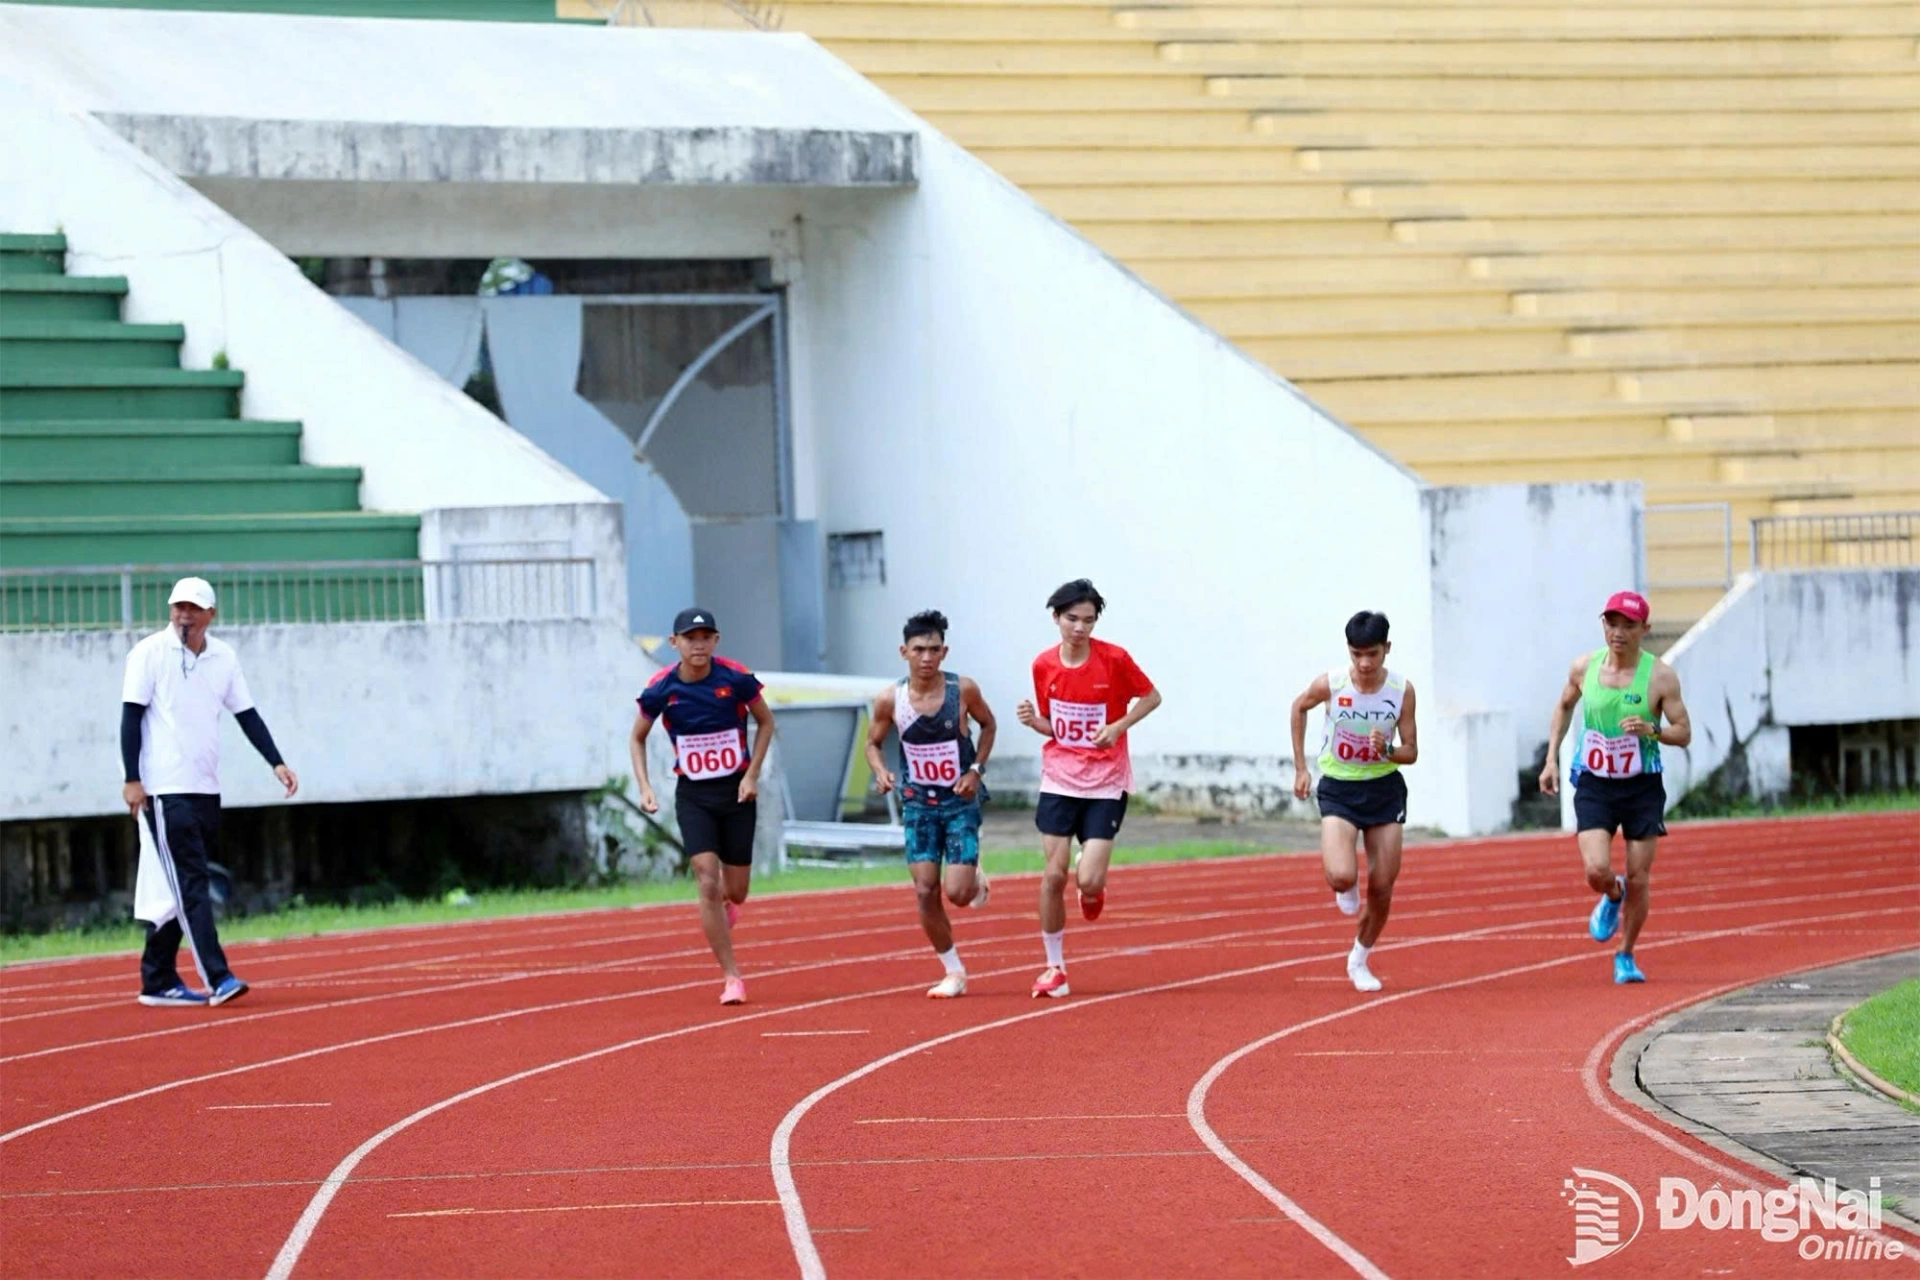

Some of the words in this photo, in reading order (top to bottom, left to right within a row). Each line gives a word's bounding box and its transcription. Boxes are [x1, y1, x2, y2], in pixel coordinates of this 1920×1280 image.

[1338, 711, 1396, 720] ANTA
[1056, 717, 1099, 742] 055
[687, 747, 736, 773] 060
[912, 759, 956, 781] 106
[1588, 748, 1634, 773] 017
